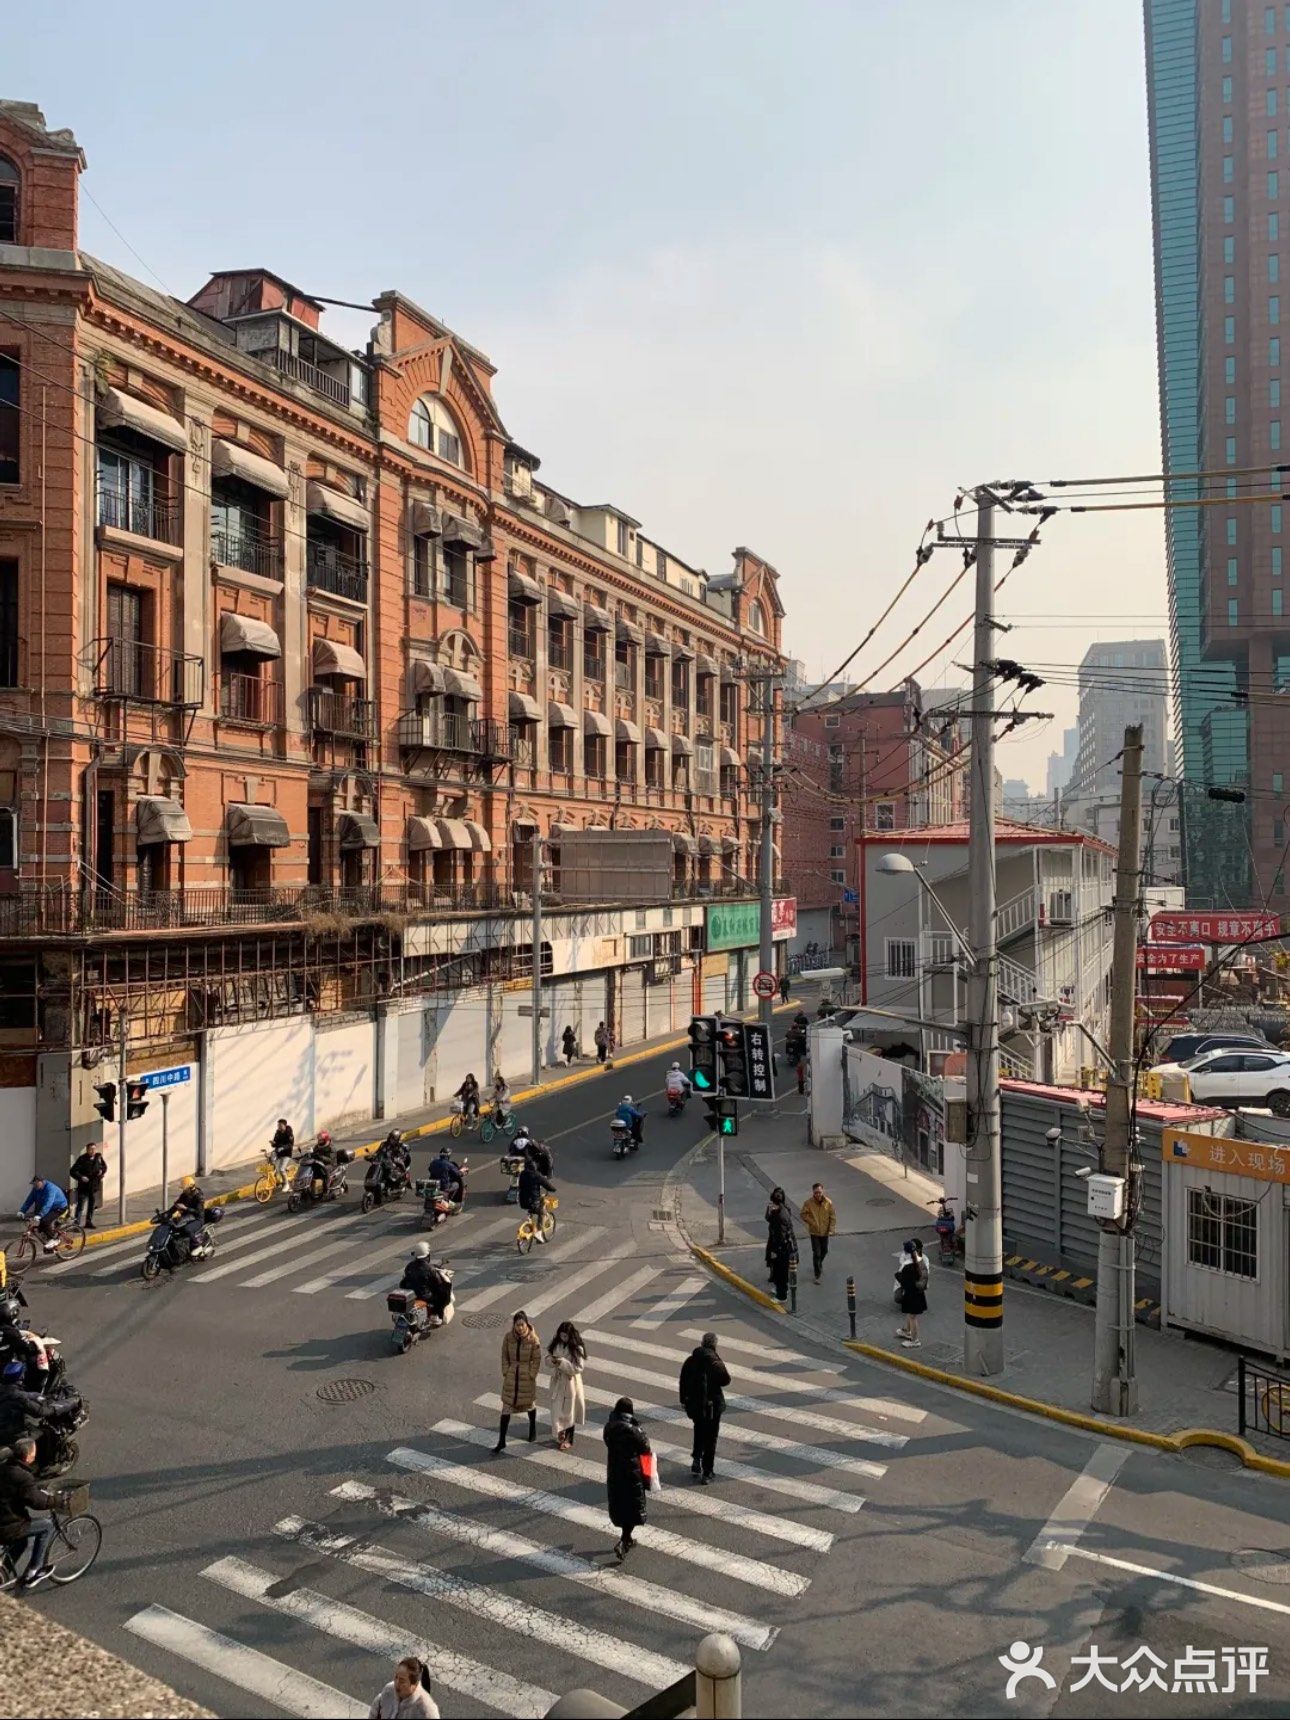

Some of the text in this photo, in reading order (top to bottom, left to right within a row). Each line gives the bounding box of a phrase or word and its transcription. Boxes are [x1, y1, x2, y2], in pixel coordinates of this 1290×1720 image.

[1136, 953, 1200, 965] 安全为了生产
[750, 1032, 767, 1092] 右转控制
[152, 1071, 180, 1086] 四川中路
[1209, 1145, 1286, 1176] 进入现场
